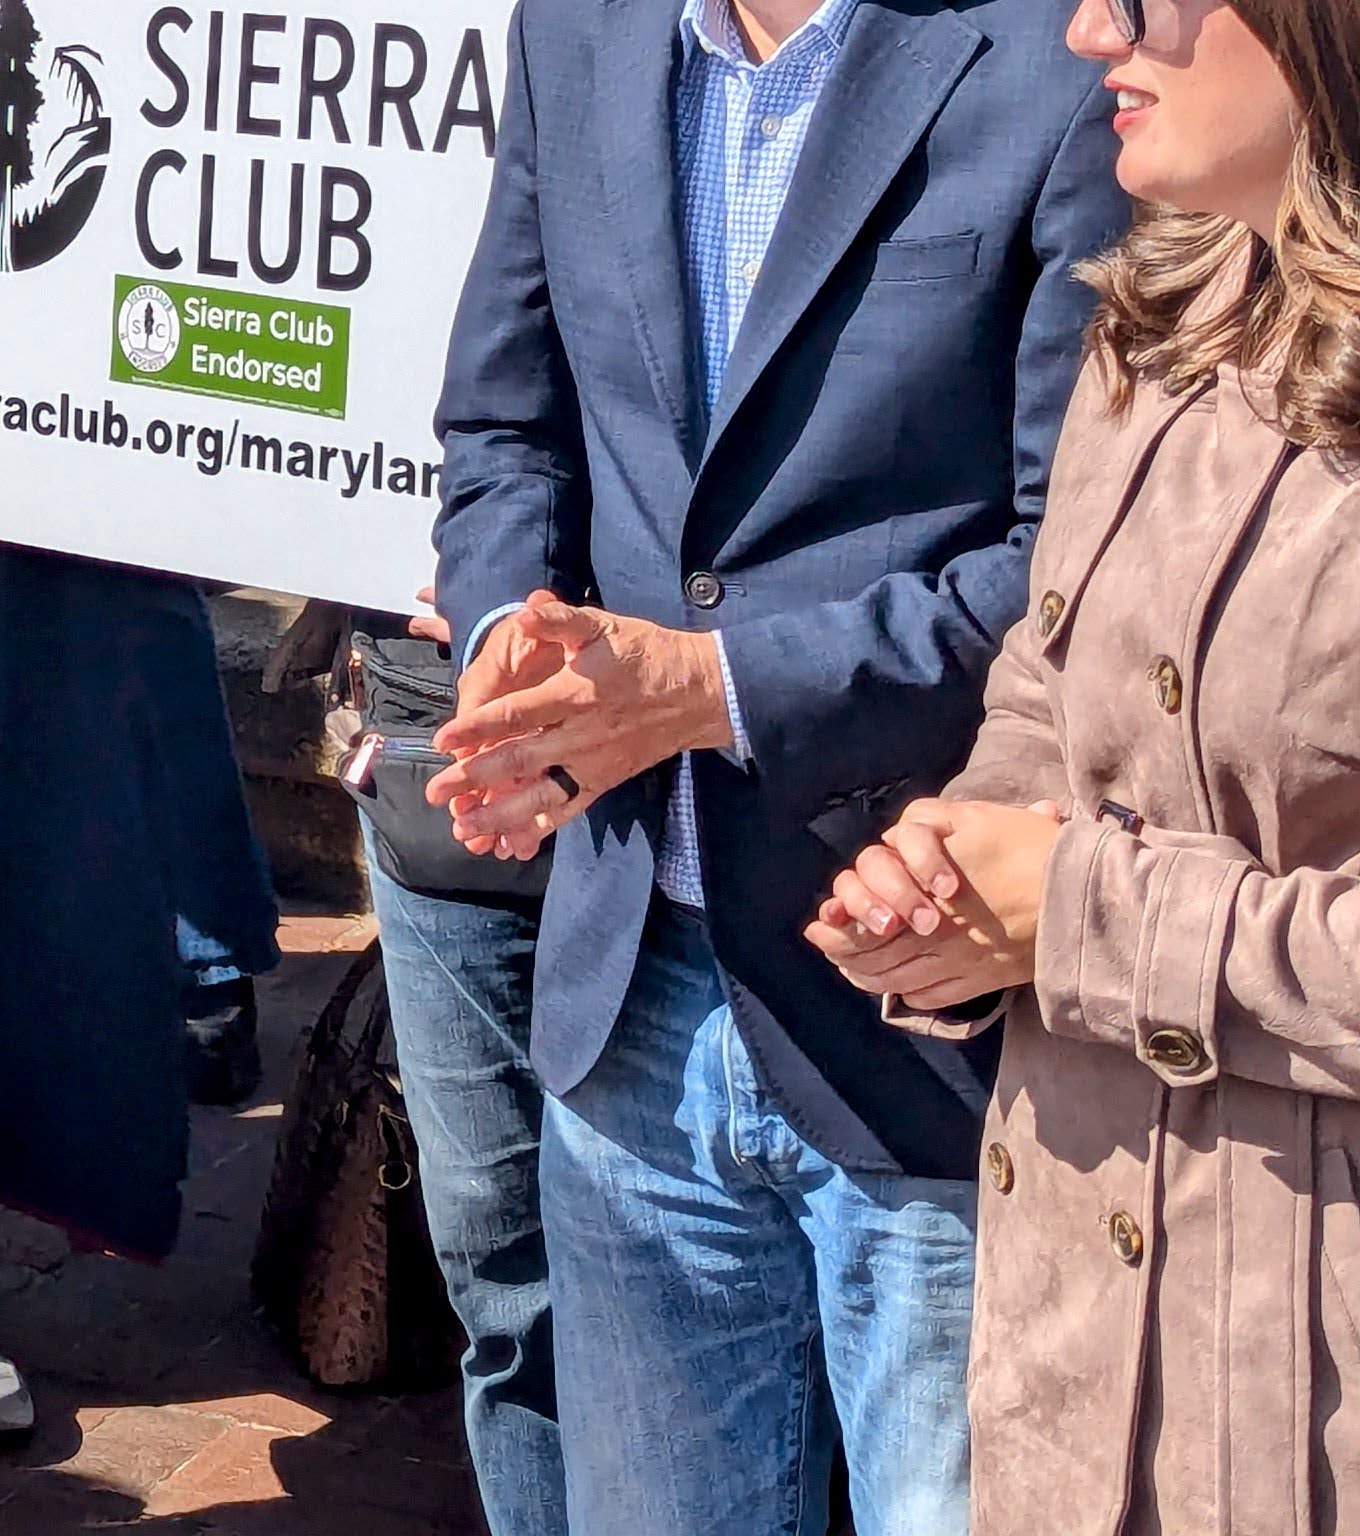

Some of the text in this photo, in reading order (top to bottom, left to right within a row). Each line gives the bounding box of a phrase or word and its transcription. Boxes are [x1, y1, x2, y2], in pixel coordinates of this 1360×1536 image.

[139, 6, 496, 158] SIERRA
[135, 149, 372, 291] CLUB
[183, 297, 261, 336] Sierra
[269, 311, 334, 346] Club
[192, 344, 321, 392] Endorsed
